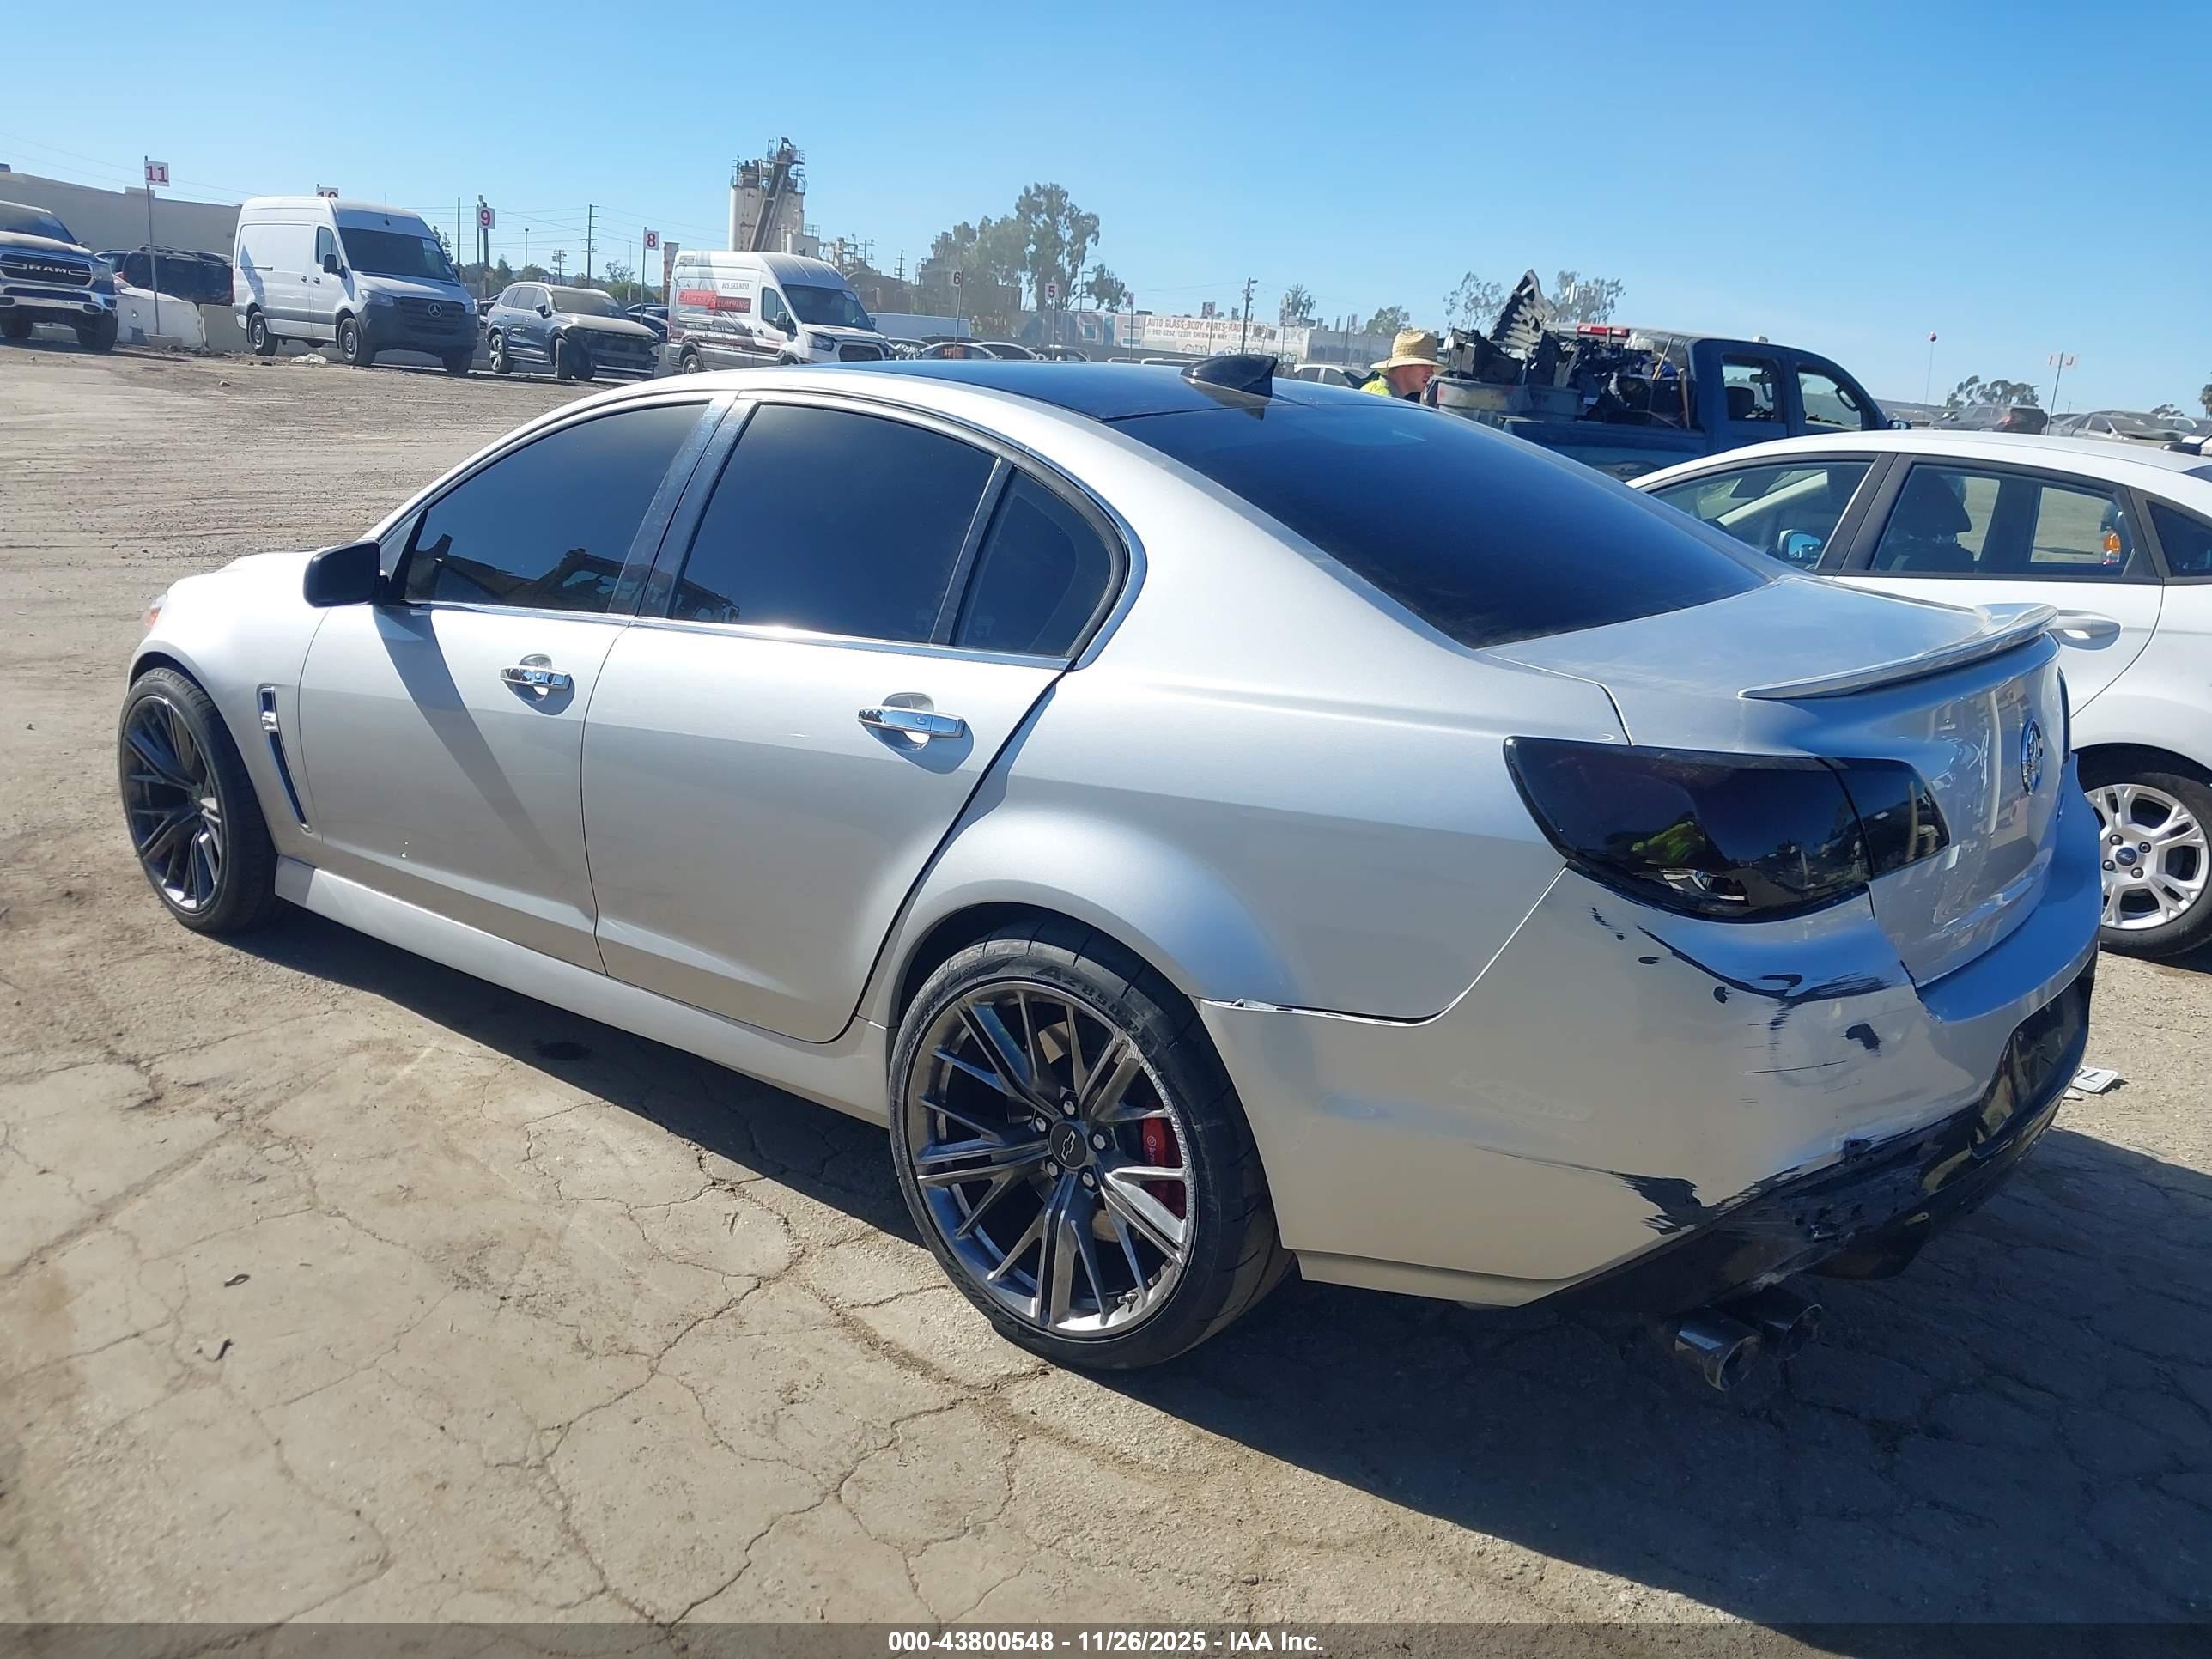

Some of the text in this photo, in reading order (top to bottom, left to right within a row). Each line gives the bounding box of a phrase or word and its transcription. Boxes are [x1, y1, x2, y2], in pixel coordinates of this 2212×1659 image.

[145, 165, 168, 183] 11
[480, 210, 491, 227] 9
[647, 233, 656, 248] 8
[28, 264, 67, 274] RAM
[953, 271, 961, 285] 6
[1048, 285, 1056, 298] 5
[708, 295, 750, 310] PLUMBING
[1206, 304, 1212, 315] 3
[1147, 318, 1164, 327] AUTO
[2066, 356, 2074, 366] J
